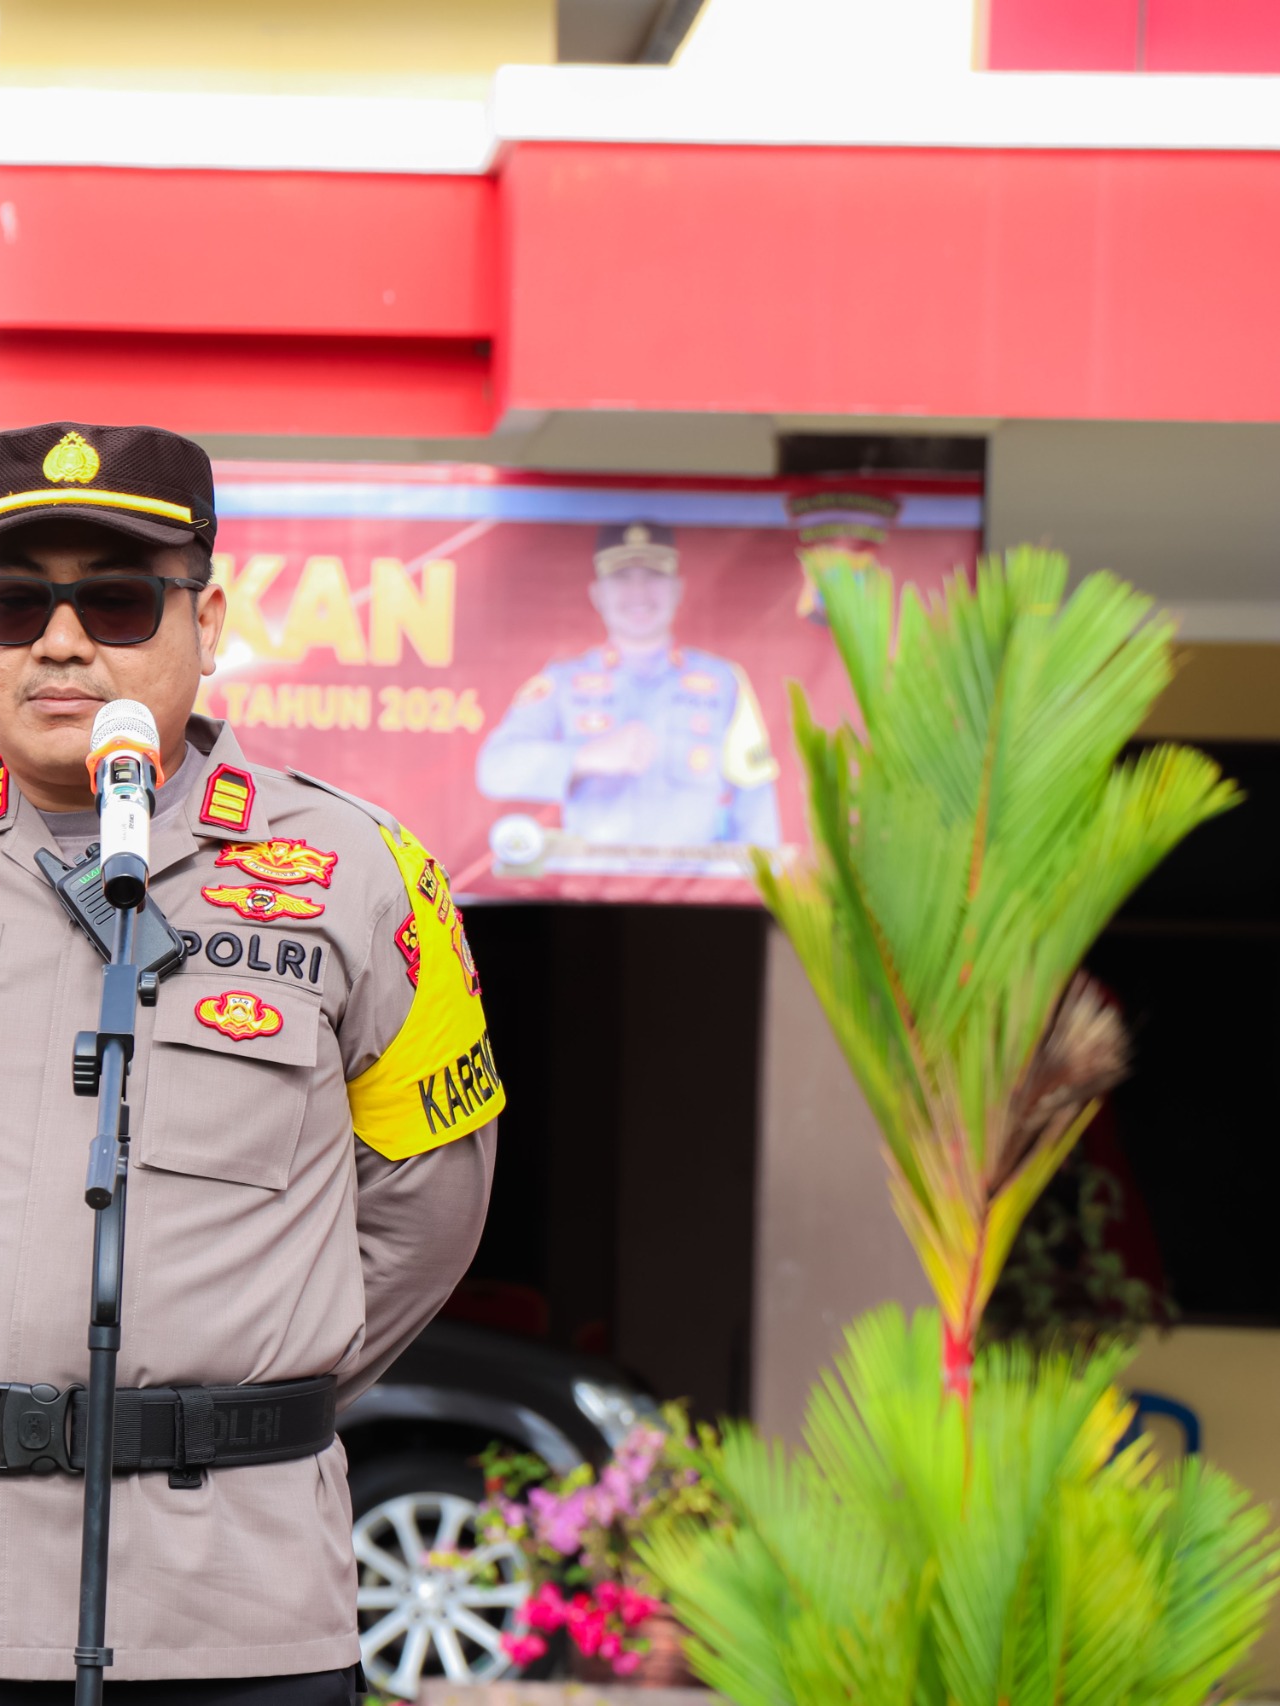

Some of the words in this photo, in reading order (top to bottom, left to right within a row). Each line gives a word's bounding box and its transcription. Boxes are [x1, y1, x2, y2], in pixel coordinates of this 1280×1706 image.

[223, 684, 371, 731] TAHUN
[378, 686, 485, 733] 2024
[178, 929, 323, 985] POLRI
